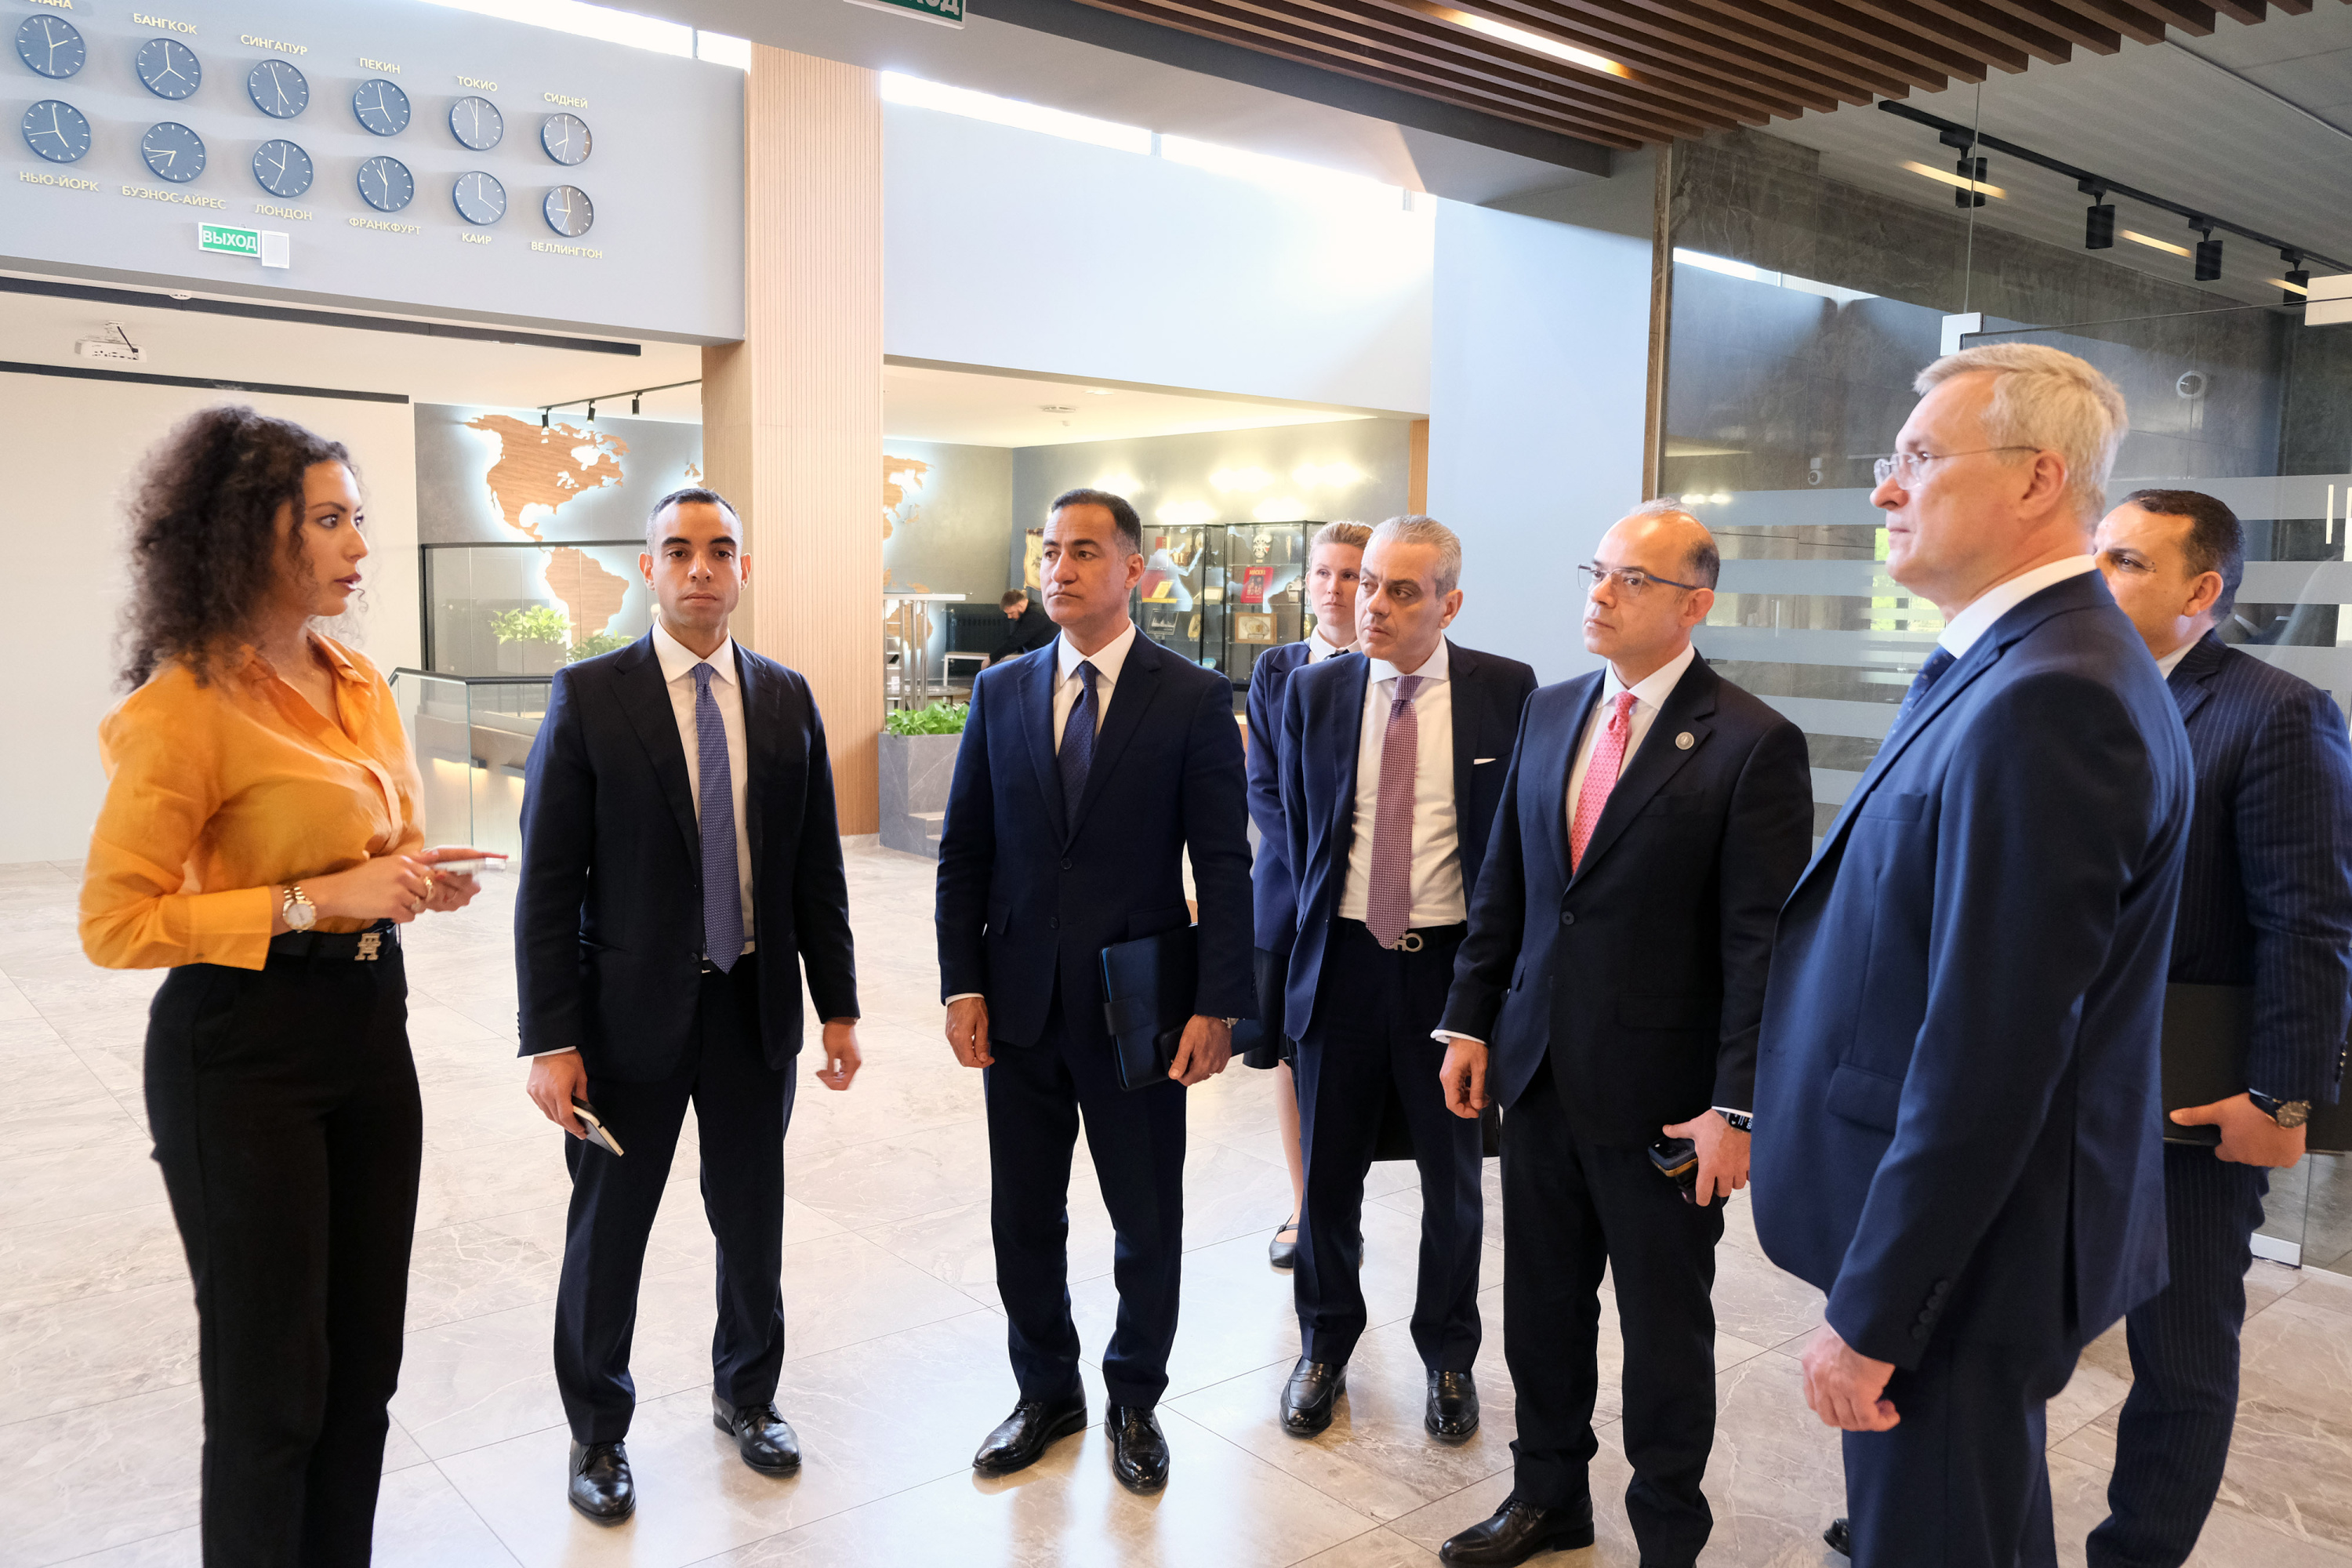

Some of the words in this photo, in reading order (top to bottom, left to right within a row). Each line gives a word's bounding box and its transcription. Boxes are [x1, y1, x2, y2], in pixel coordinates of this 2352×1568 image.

[134, 13, 198, 34] БАНГКОК
[241, 34, 308, 55] СИНГАПУР
[359, 58, 401, 74] ПЕКИН
[457, 76, 498, 92] ТОКИО
[544, 93, 588, 109] СИДНЕЙ
[20, 172, 99, 191] НЬЮ-ЙОРК
[122, 186, 227, 209] БУЭНОС-АЙРЕС
[255, 204, 313, 220] ЛОНДОН
[349, 218, 421, 234] ФРАНКФУРТ
[202, 230, 256, 251] ВЫХОД
[462, 233, 492, 245] КАИР
[531, 241, 603, 259] ВЕЛЛИНГТОН
